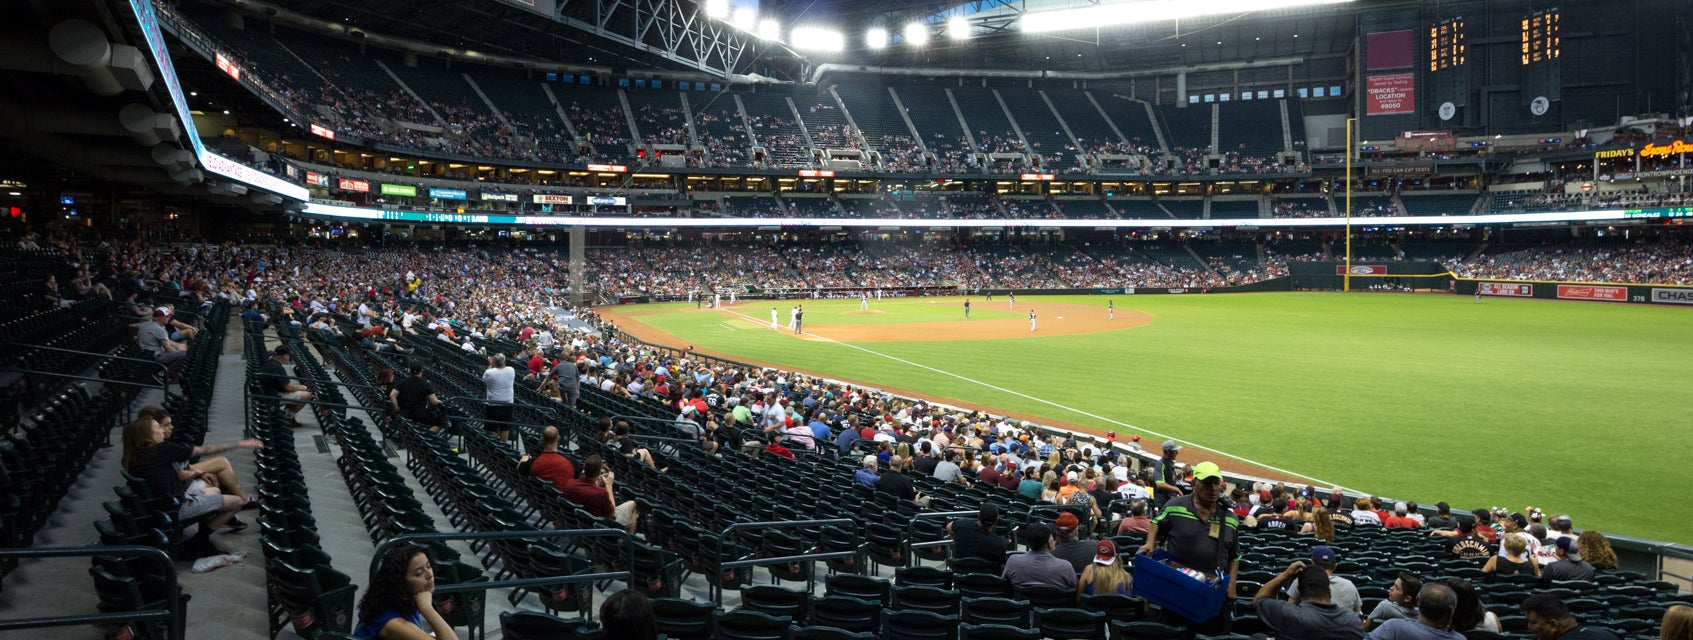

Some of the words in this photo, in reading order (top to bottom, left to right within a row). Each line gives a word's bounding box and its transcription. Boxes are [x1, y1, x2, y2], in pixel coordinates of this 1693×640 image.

[1595, 149, 1634, 159] FRIDAY'S
[707, 398, 717, 406] 56
[1268, 520, 1287, 529] ABREU
